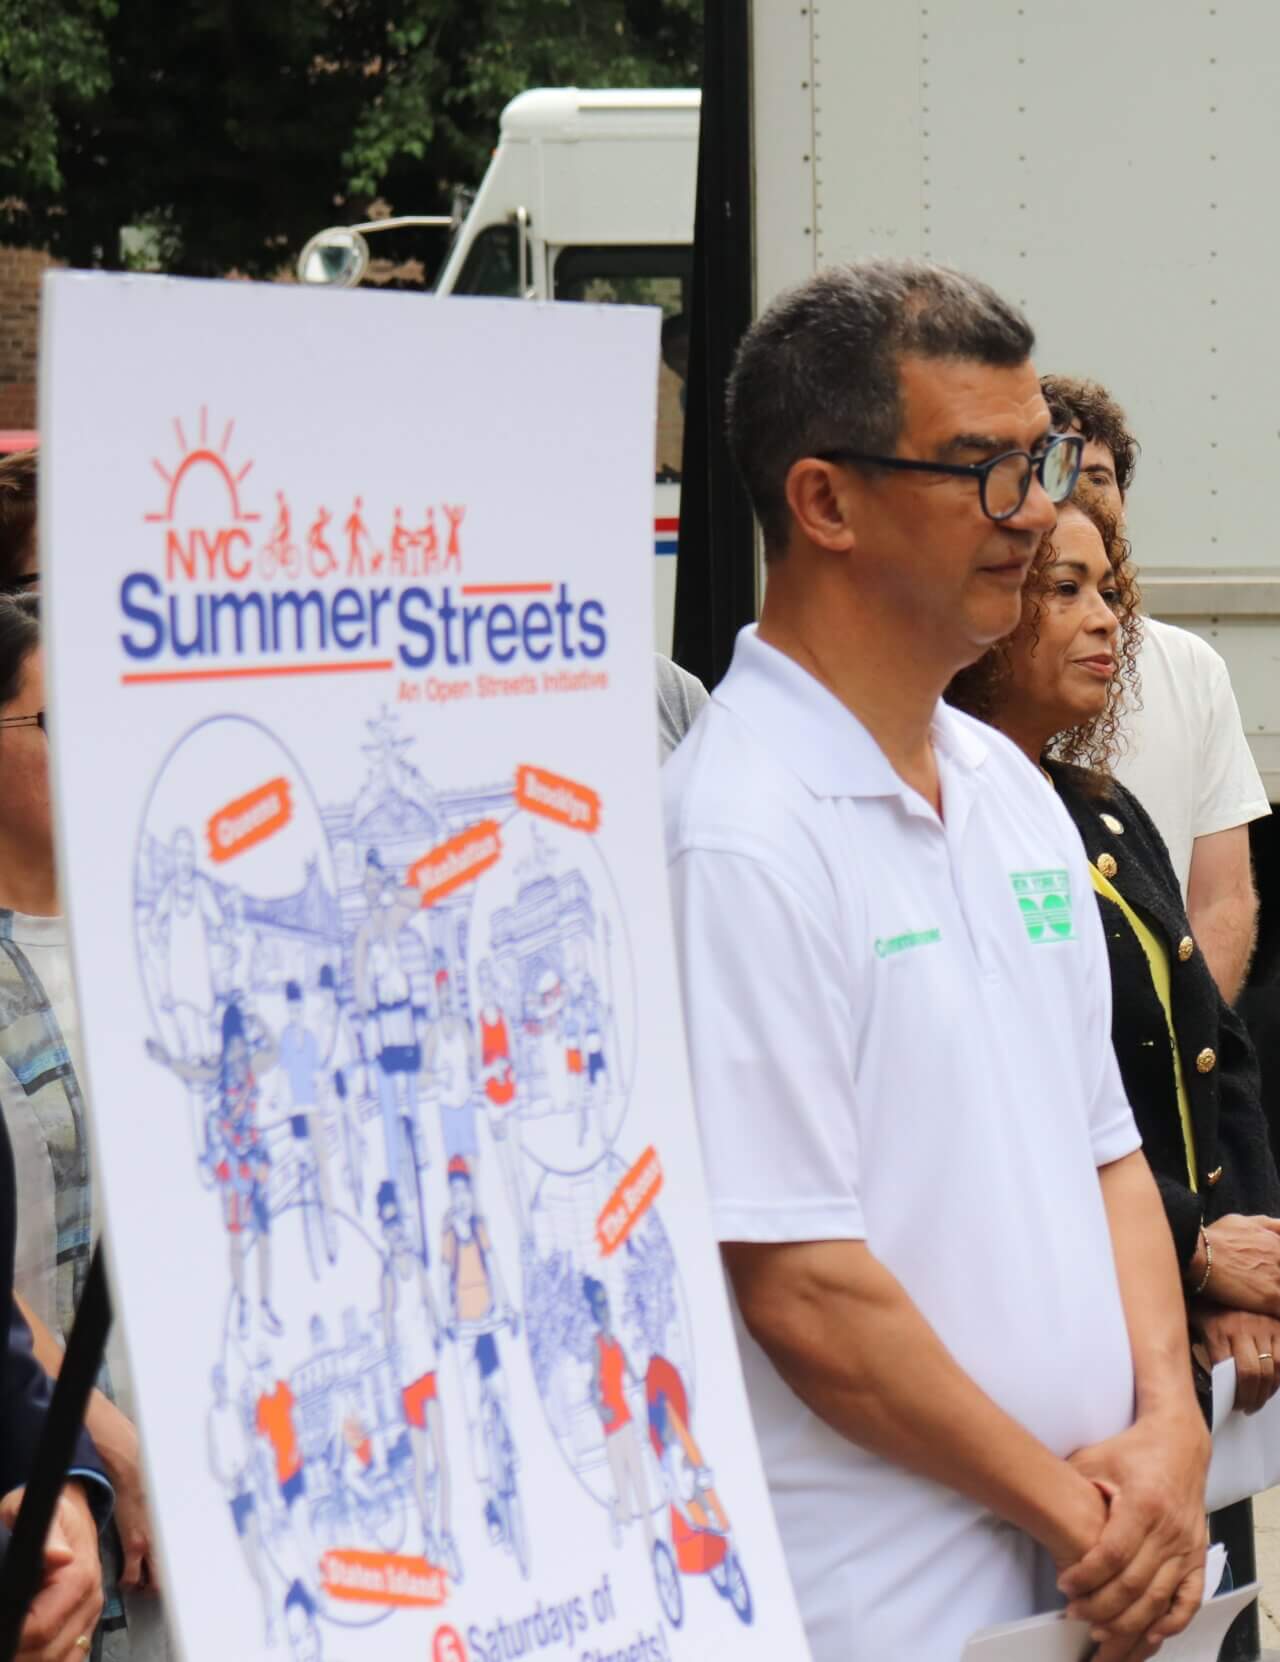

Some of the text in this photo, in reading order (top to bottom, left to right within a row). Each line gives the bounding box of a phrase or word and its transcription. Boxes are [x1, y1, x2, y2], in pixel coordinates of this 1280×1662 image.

[165, 527, 252, 581] NYC
[397, 667, 610, 705] An Open Streets Initiative
[467, 1596, 588, 1662] Saturdays
[591, 1572, 615, 1625] of
